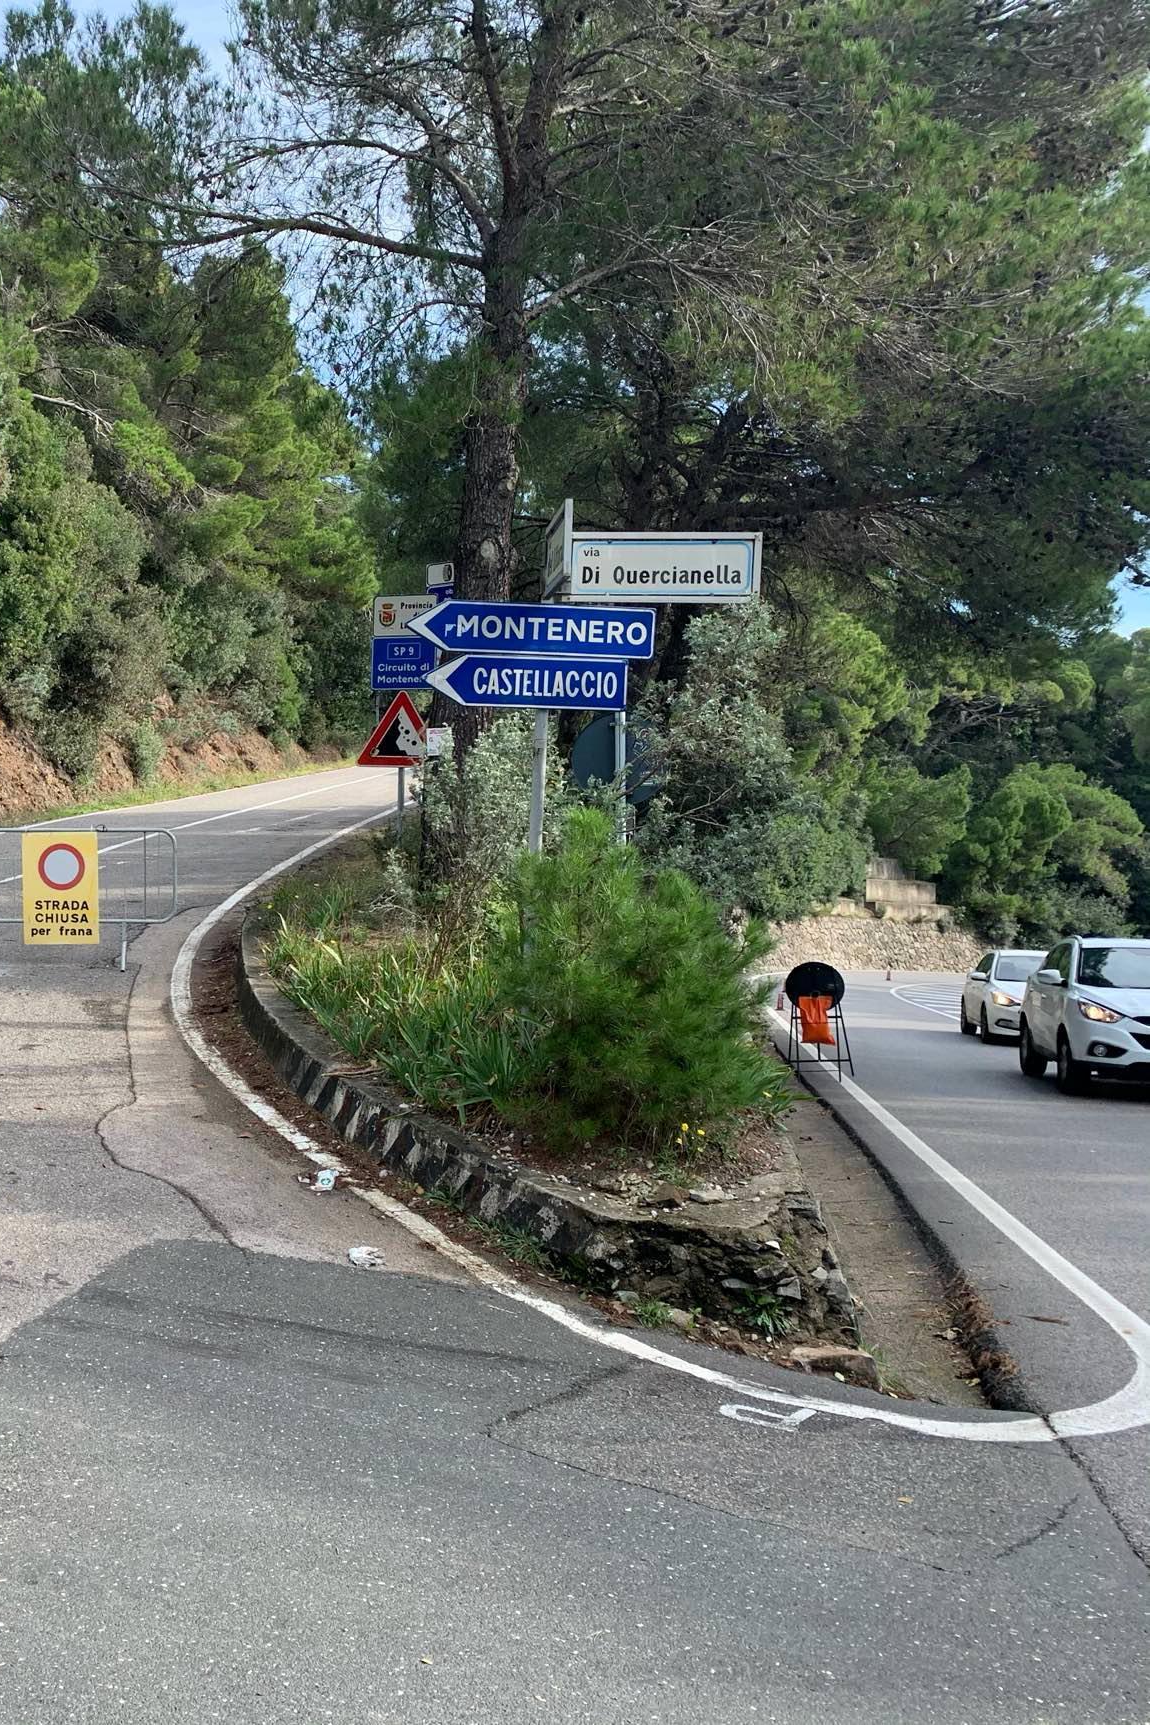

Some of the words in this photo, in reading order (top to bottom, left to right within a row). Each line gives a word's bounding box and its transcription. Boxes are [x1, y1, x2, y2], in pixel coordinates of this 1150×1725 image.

[583, 547, 600, 557] via
[582, 566, 600, 584] Di
[613, 565, 742, 585] Quercianella
[400, 602, 433, 610] Provincia
[456, 614, 648, 646] MONTENERO
[393, 646, 406, 656] SP
[408, 646, 414, 656] 9
[377, 663, 417, 672] Circuito
[420, 663, 430, 671] di
[473, 667, 618, 699] CASTELLACCIO
[35, 900, 89, 910] STRADA
[35, 913, 89, 923] CHIUSA
[31, 927, 51, 937] per
[59, 926, 93, 936] frana
